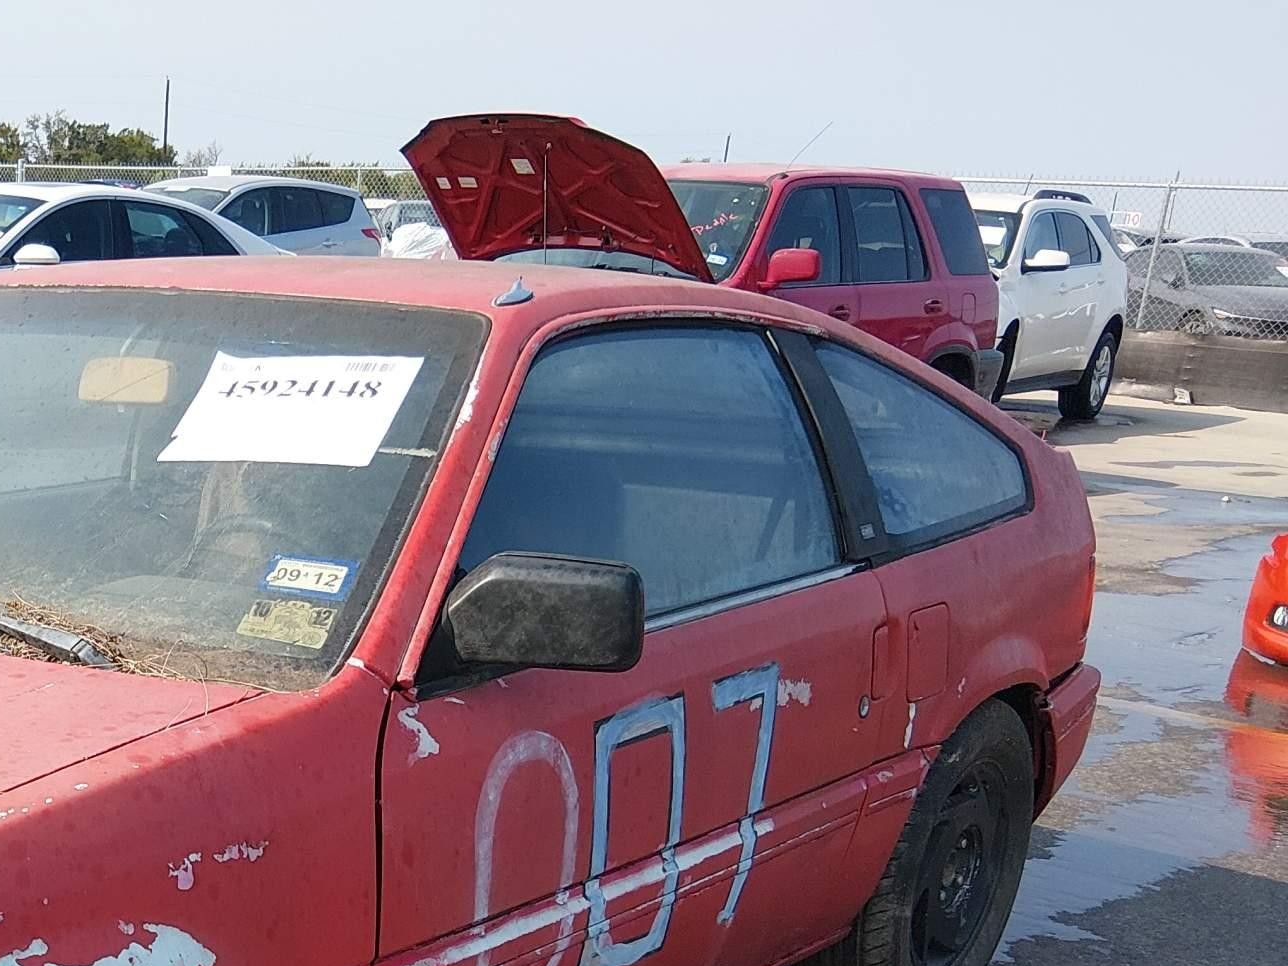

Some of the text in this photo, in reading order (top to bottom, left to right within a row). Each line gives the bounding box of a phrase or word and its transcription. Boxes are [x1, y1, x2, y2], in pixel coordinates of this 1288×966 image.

[219, 379, 382, 398] 45924148
[276, 567, 301, 582] 09
[314, 571, 339, 588] 12
